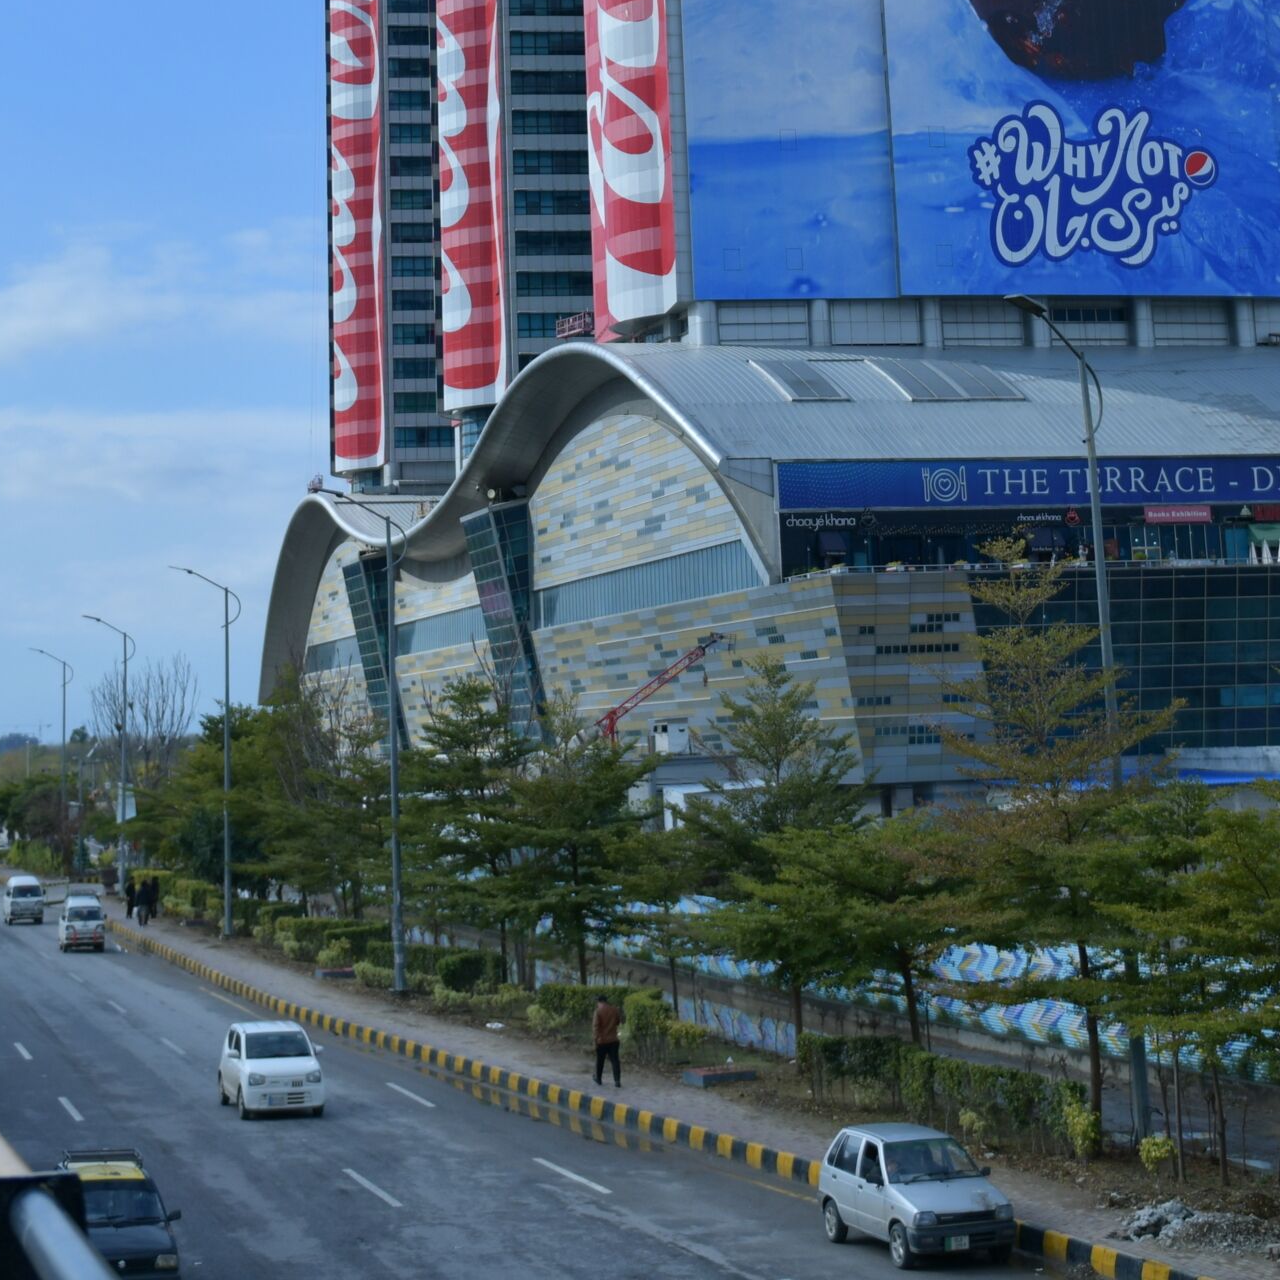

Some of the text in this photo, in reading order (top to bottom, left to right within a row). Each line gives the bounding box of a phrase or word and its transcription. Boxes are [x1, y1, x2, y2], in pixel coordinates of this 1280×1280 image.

[978, 468, 1050, 496] THE
[1059, 466, 1216, 495] TERRACE
[1171, 509, 1208, 518] Exhibition
